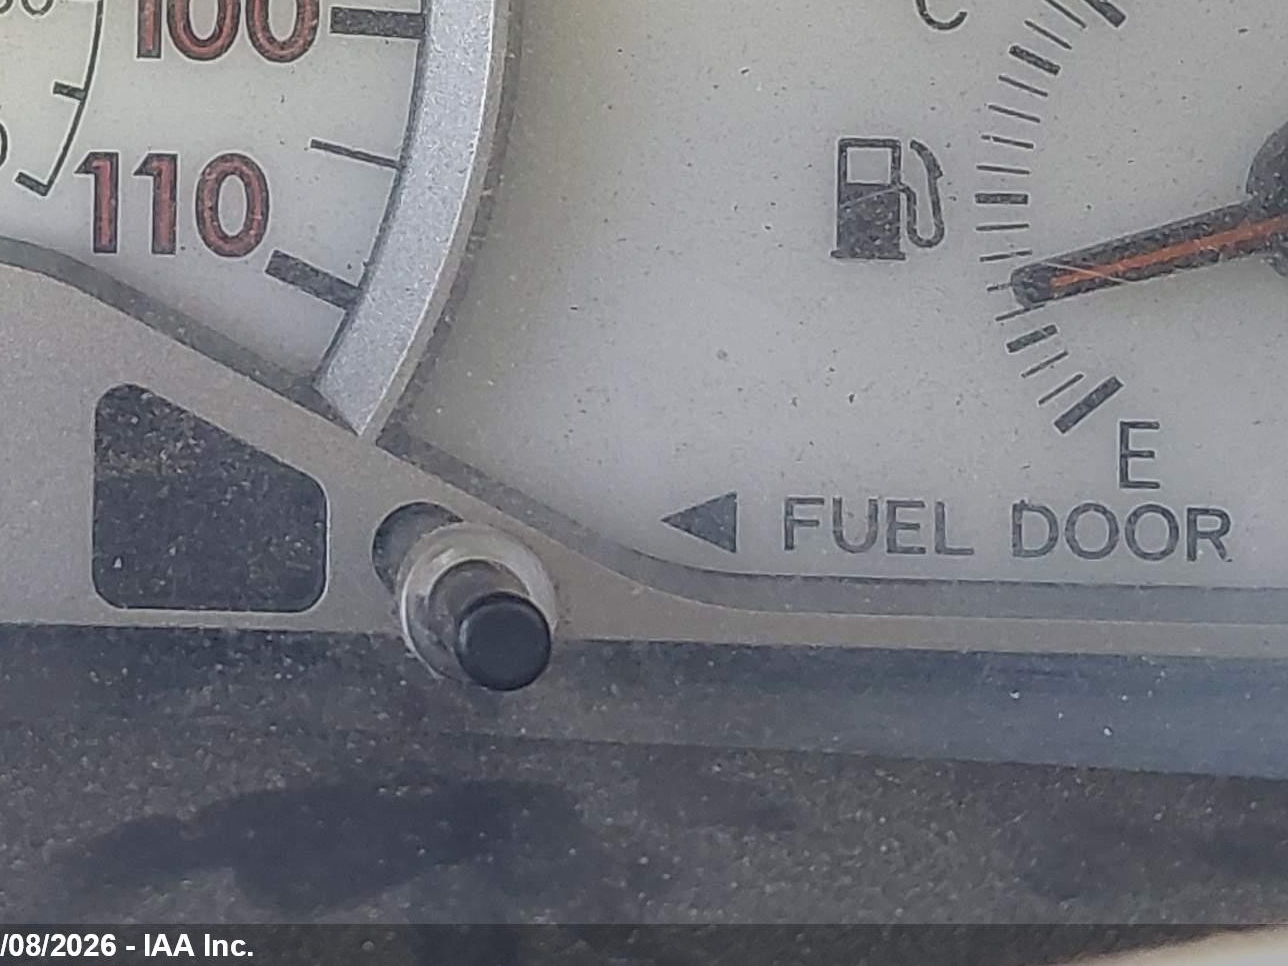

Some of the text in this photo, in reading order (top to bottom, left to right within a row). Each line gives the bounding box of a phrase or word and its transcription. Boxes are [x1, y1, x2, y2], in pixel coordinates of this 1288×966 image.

[75, 151, 270, 259] 110
[1119, 421, 1162, 490] E
[783, 497, 1233, 564] FUEL DOOR
